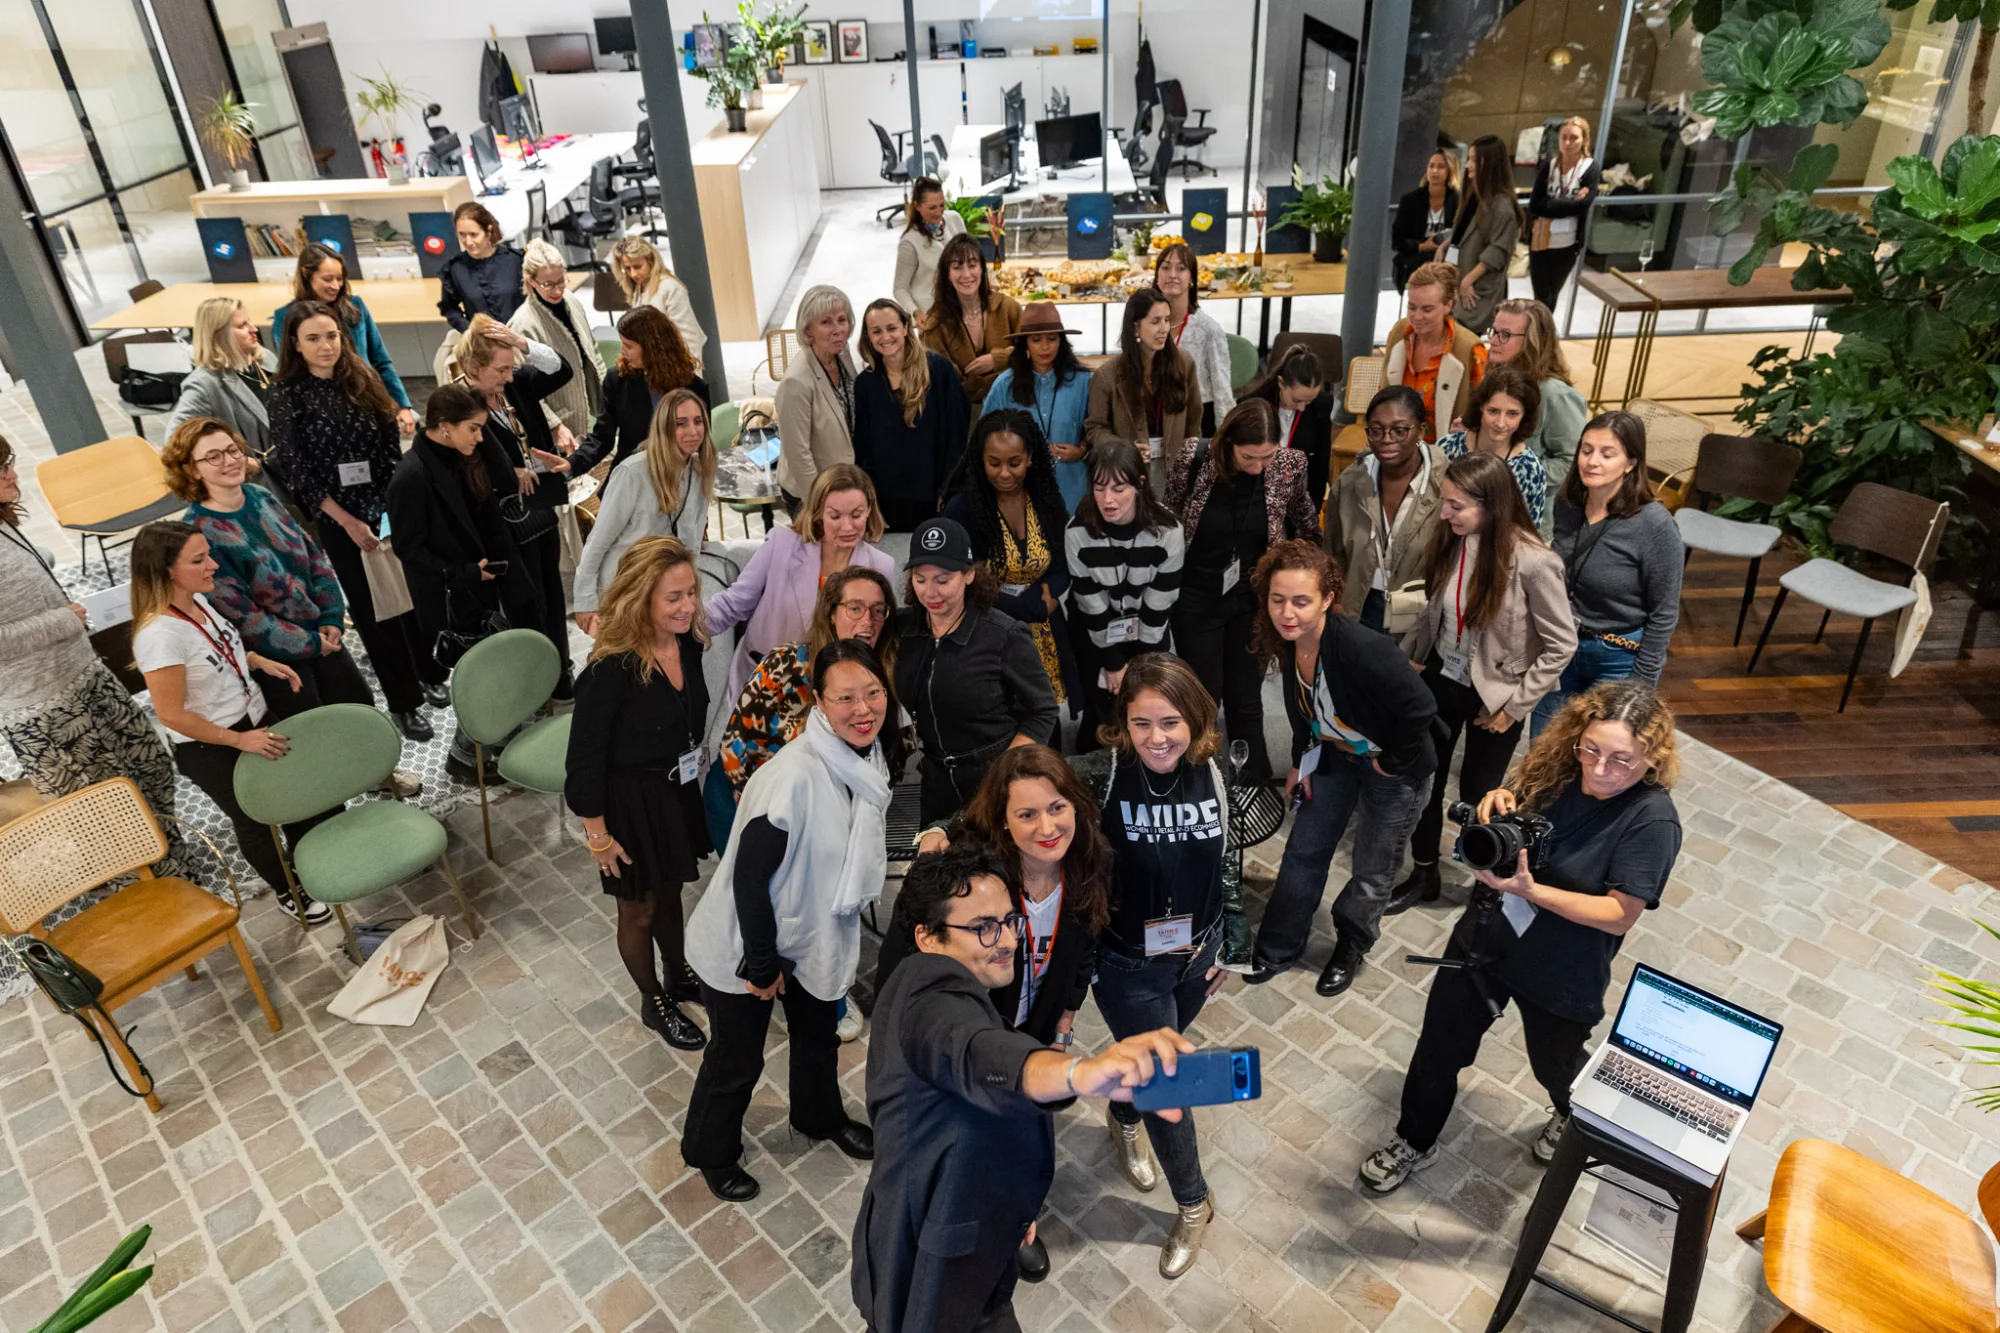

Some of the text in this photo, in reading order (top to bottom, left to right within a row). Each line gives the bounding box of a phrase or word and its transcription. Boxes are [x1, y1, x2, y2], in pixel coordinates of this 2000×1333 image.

[1120, 799, 1222, 843] WIRE
[1125, 825, 1149, 834] WOMEN
[1191, 820, 1221, 832] ECOMMERCE
